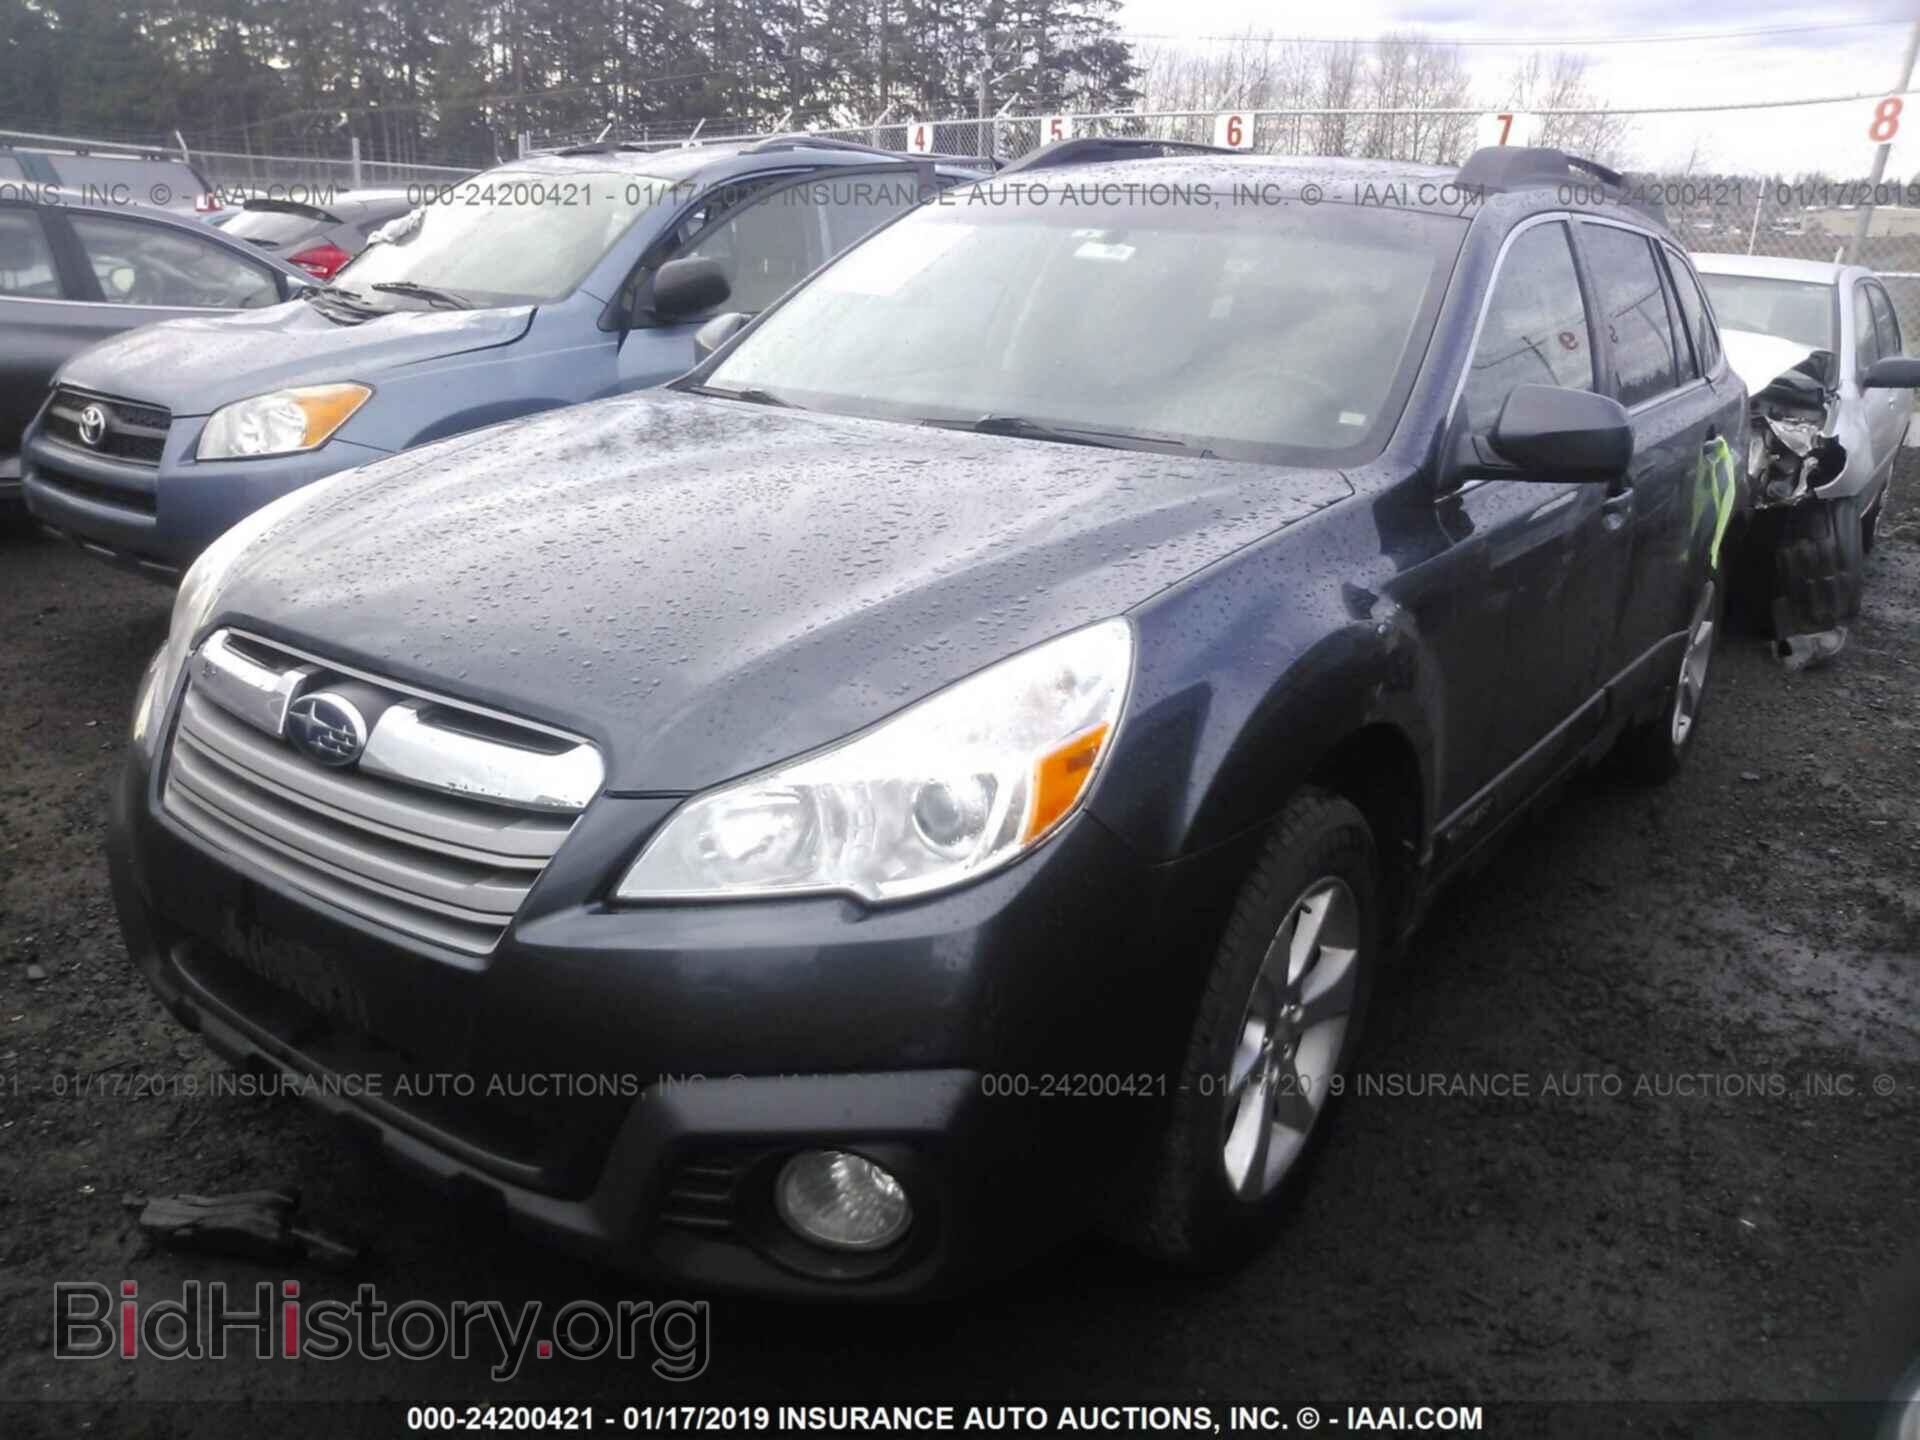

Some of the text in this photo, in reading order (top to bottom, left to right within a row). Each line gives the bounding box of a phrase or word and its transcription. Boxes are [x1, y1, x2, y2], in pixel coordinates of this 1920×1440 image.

[1050, 119, 1063, 140] 5
[1226, 115, 1243, 146] 6
[1497, 114, 1513, 145] 7
[1869, 96, 1904, 142] 8
[914, 126, 925, 150] 4
